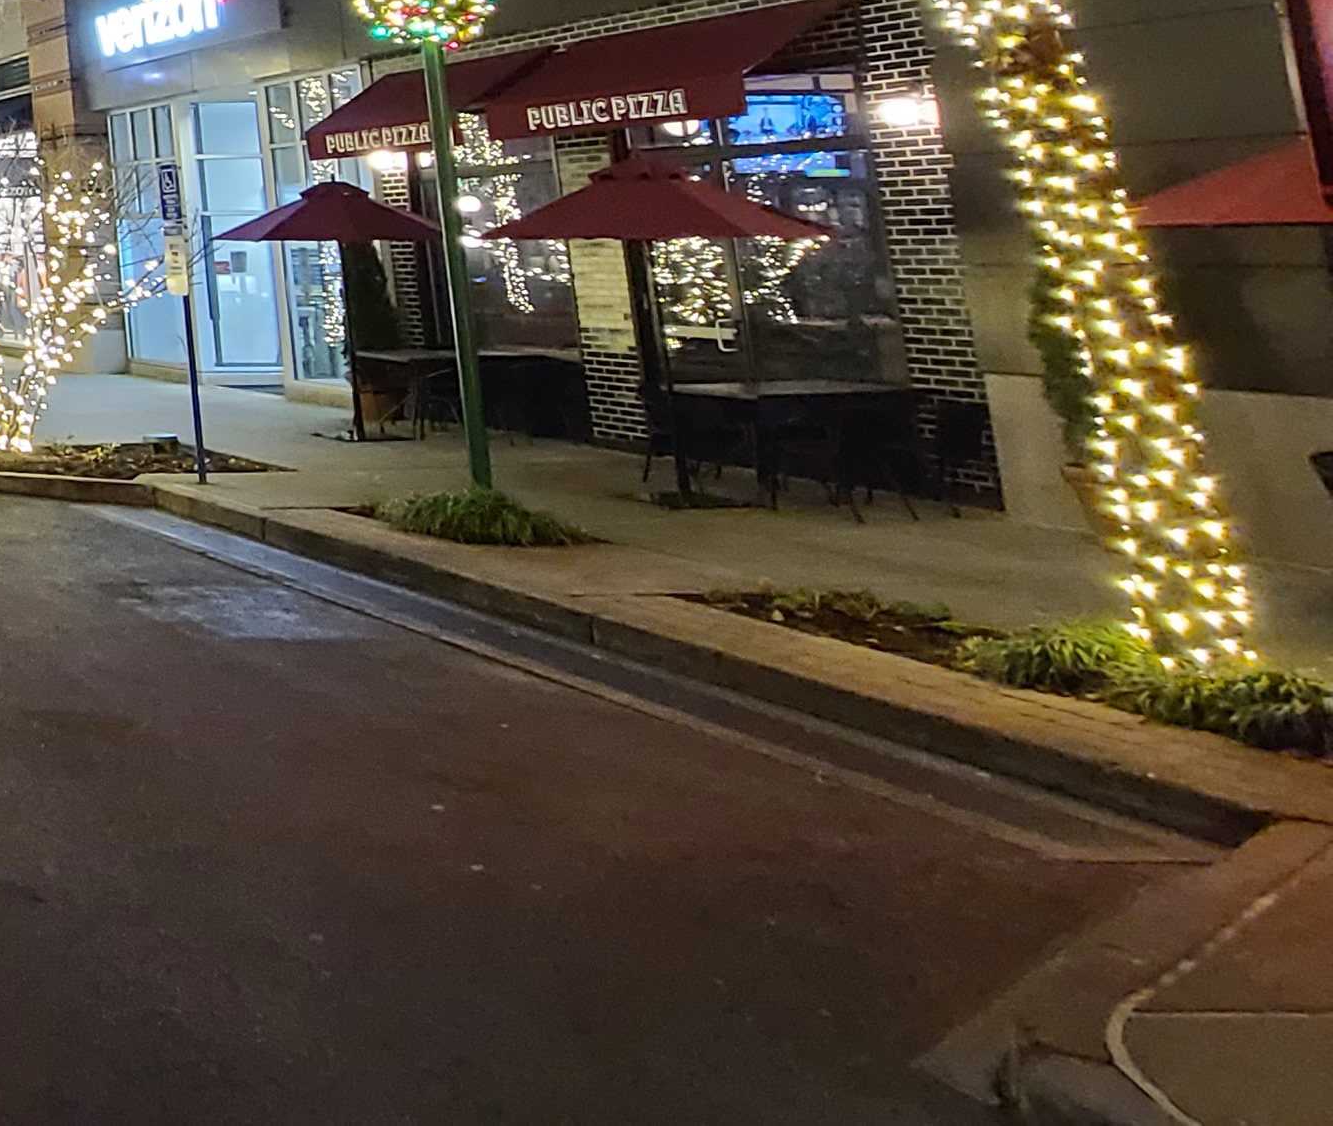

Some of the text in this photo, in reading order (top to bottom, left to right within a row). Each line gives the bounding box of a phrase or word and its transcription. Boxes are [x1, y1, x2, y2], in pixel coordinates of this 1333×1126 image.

[527, 88, 688, 132] PUBLIC PIZZA
[325, 123, 432, 154] PUBLIC PIZZA
